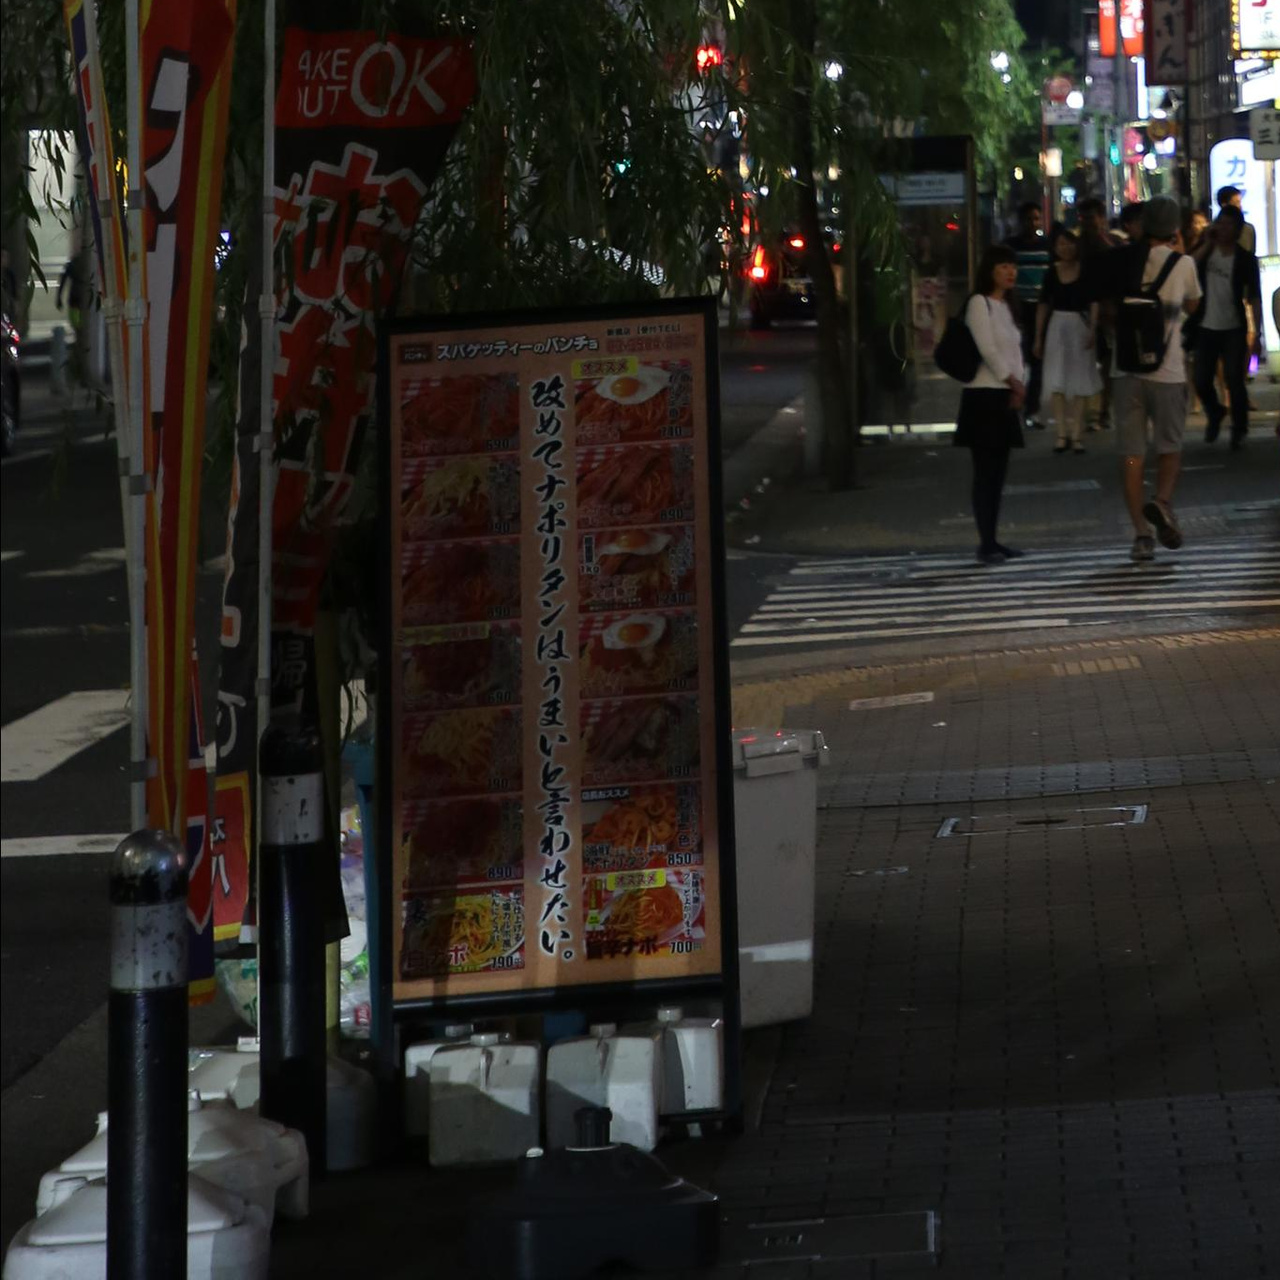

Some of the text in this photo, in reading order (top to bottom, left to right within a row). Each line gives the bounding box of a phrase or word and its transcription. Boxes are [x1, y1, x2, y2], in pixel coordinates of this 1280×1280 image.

[351, 41, 455, 119] OK
[437, 335, 599, 361] スパゲッティーのパンチョ
[583, 358, 628, 375] オススメ
[530, 374, 574, 960] 改めてナポリタンはうまいと言わせたい。
[614, 873, 656, 886] オススメ
